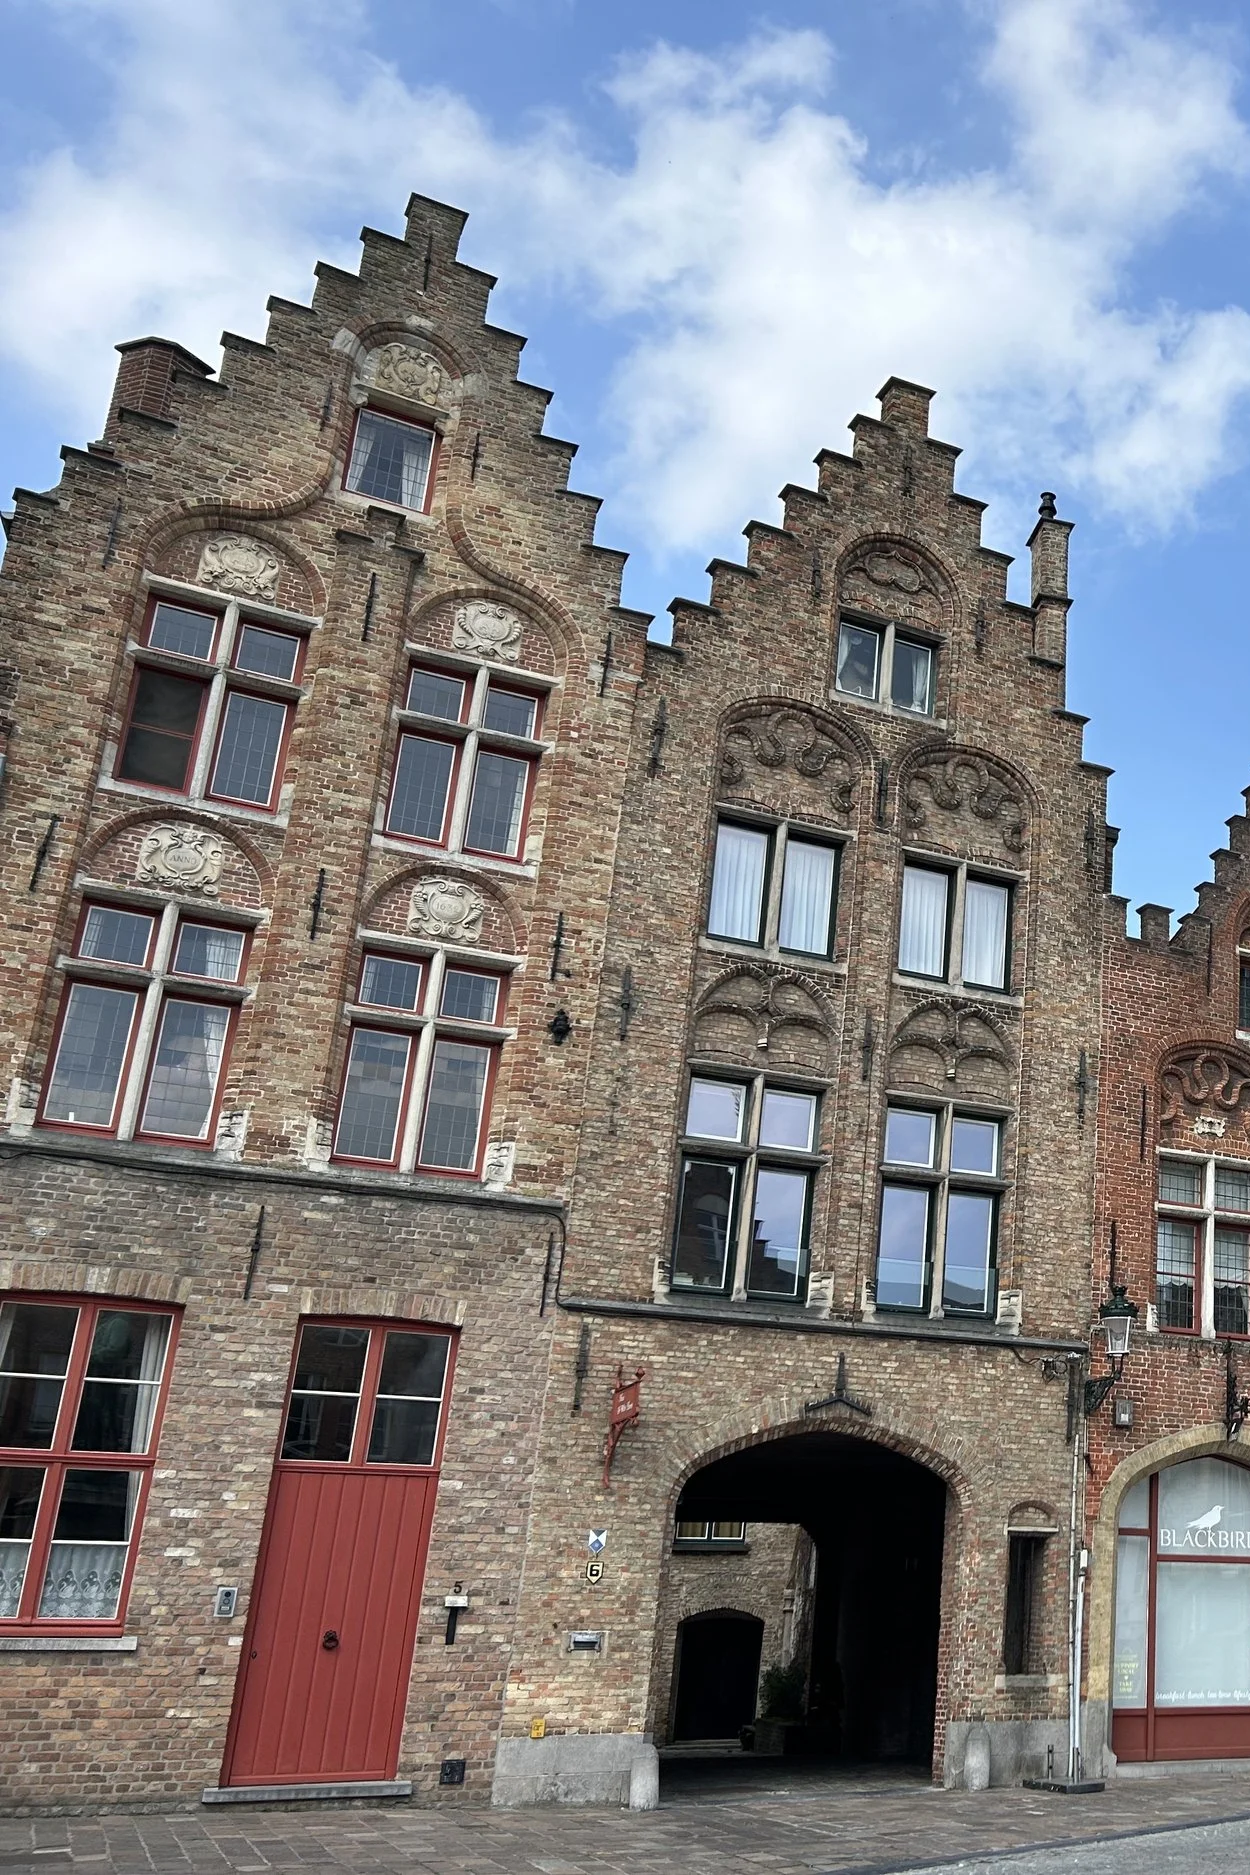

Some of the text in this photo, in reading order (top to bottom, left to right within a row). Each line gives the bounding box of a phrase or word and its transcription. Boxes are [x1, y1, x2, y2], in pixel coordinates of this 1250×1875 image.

[168, 854, 197, 866] ANNO
[589, 1564, 600, 1577] 6
[453, 1580, 464, 1594] 5
[1155, 1690, 1185, 1703] breakfast
